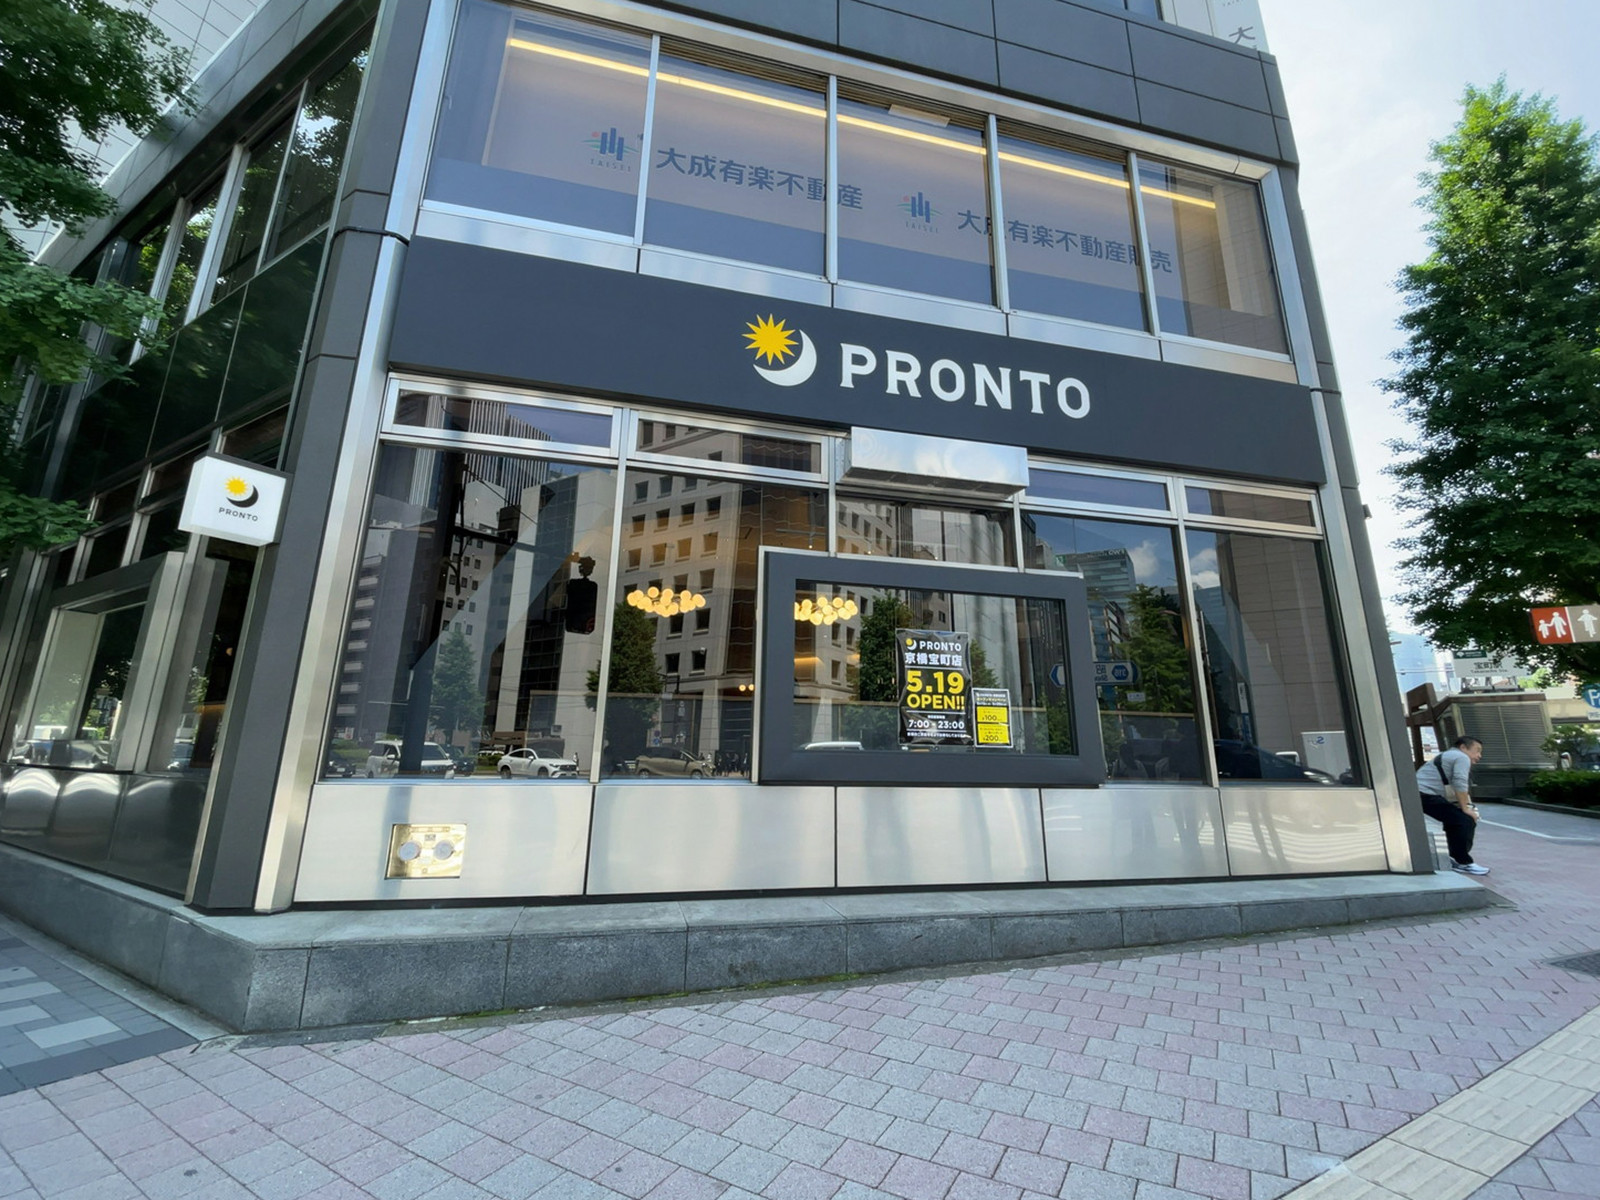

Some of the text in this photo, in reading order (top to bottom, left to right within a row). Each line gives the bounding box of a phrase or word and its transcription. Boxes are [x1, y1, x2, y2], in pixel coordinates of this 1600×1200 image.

[839, 342, 1091, 419] PRONTO
[218, 506, 259, 522] PRONTO
[919, 641, 962, 652] PRONTO
[906, 670, 965, 695] 5.19
[906, 693, 965, 710] OPEN!!
[908, 719, 930, 728] 7:00
[937, 720, 965, 729] 23:00
